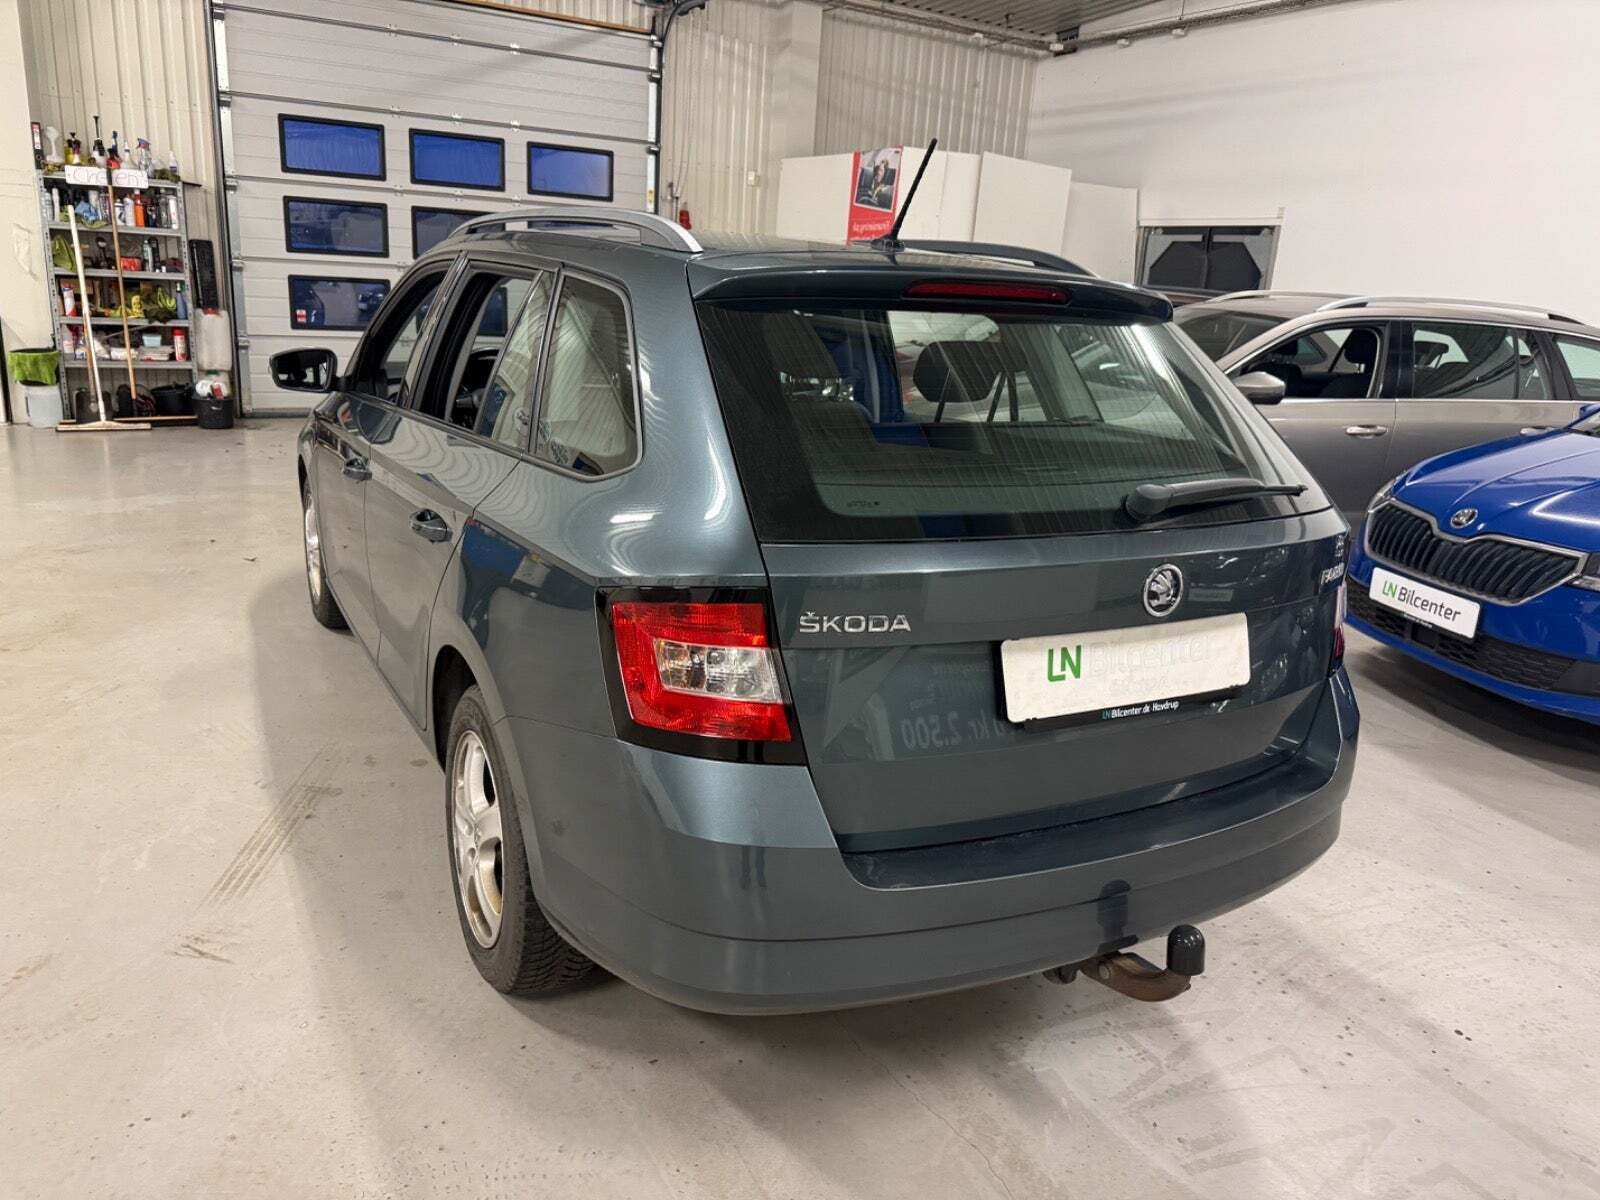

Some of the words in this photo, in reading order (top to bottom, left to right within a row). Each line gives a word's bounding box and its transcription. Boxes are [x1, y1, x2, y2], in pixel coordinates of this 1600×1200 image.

[1382, 579, 1397, 598] LN
[1398, 586, 1462, 621] Bilcenter
[799, 611, 911, 632] ŠKODA
[1047, 645, 1082, 682] LN
